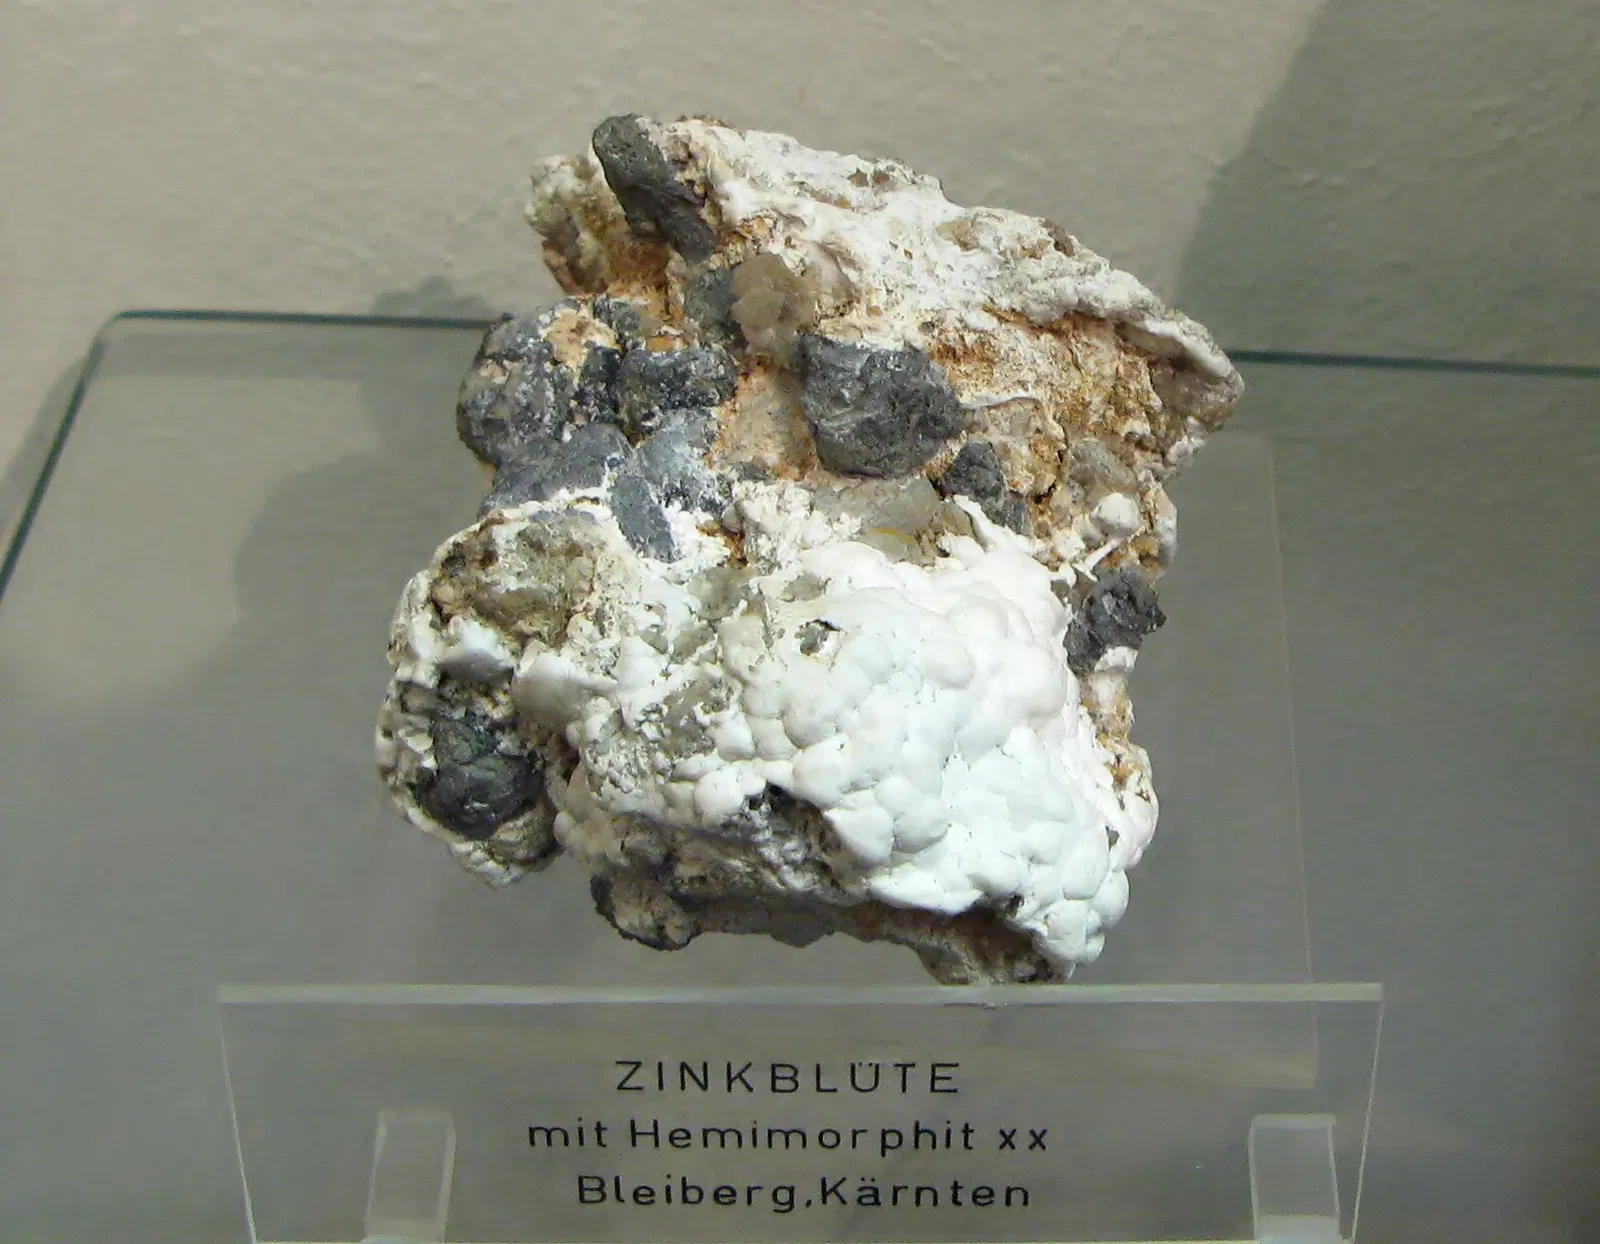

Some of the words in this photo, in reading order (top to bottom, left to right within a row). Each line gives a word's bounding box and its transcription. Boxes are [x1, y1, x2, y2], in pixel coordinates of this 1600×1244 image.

[615, 1061, 960, 1093] ZINKBLÜTE
[528, 1118, 609, 1149] mit
[629, 1118, 975, 1159] Hemimorphit
[998, 1128, 1048, 1151] xx
